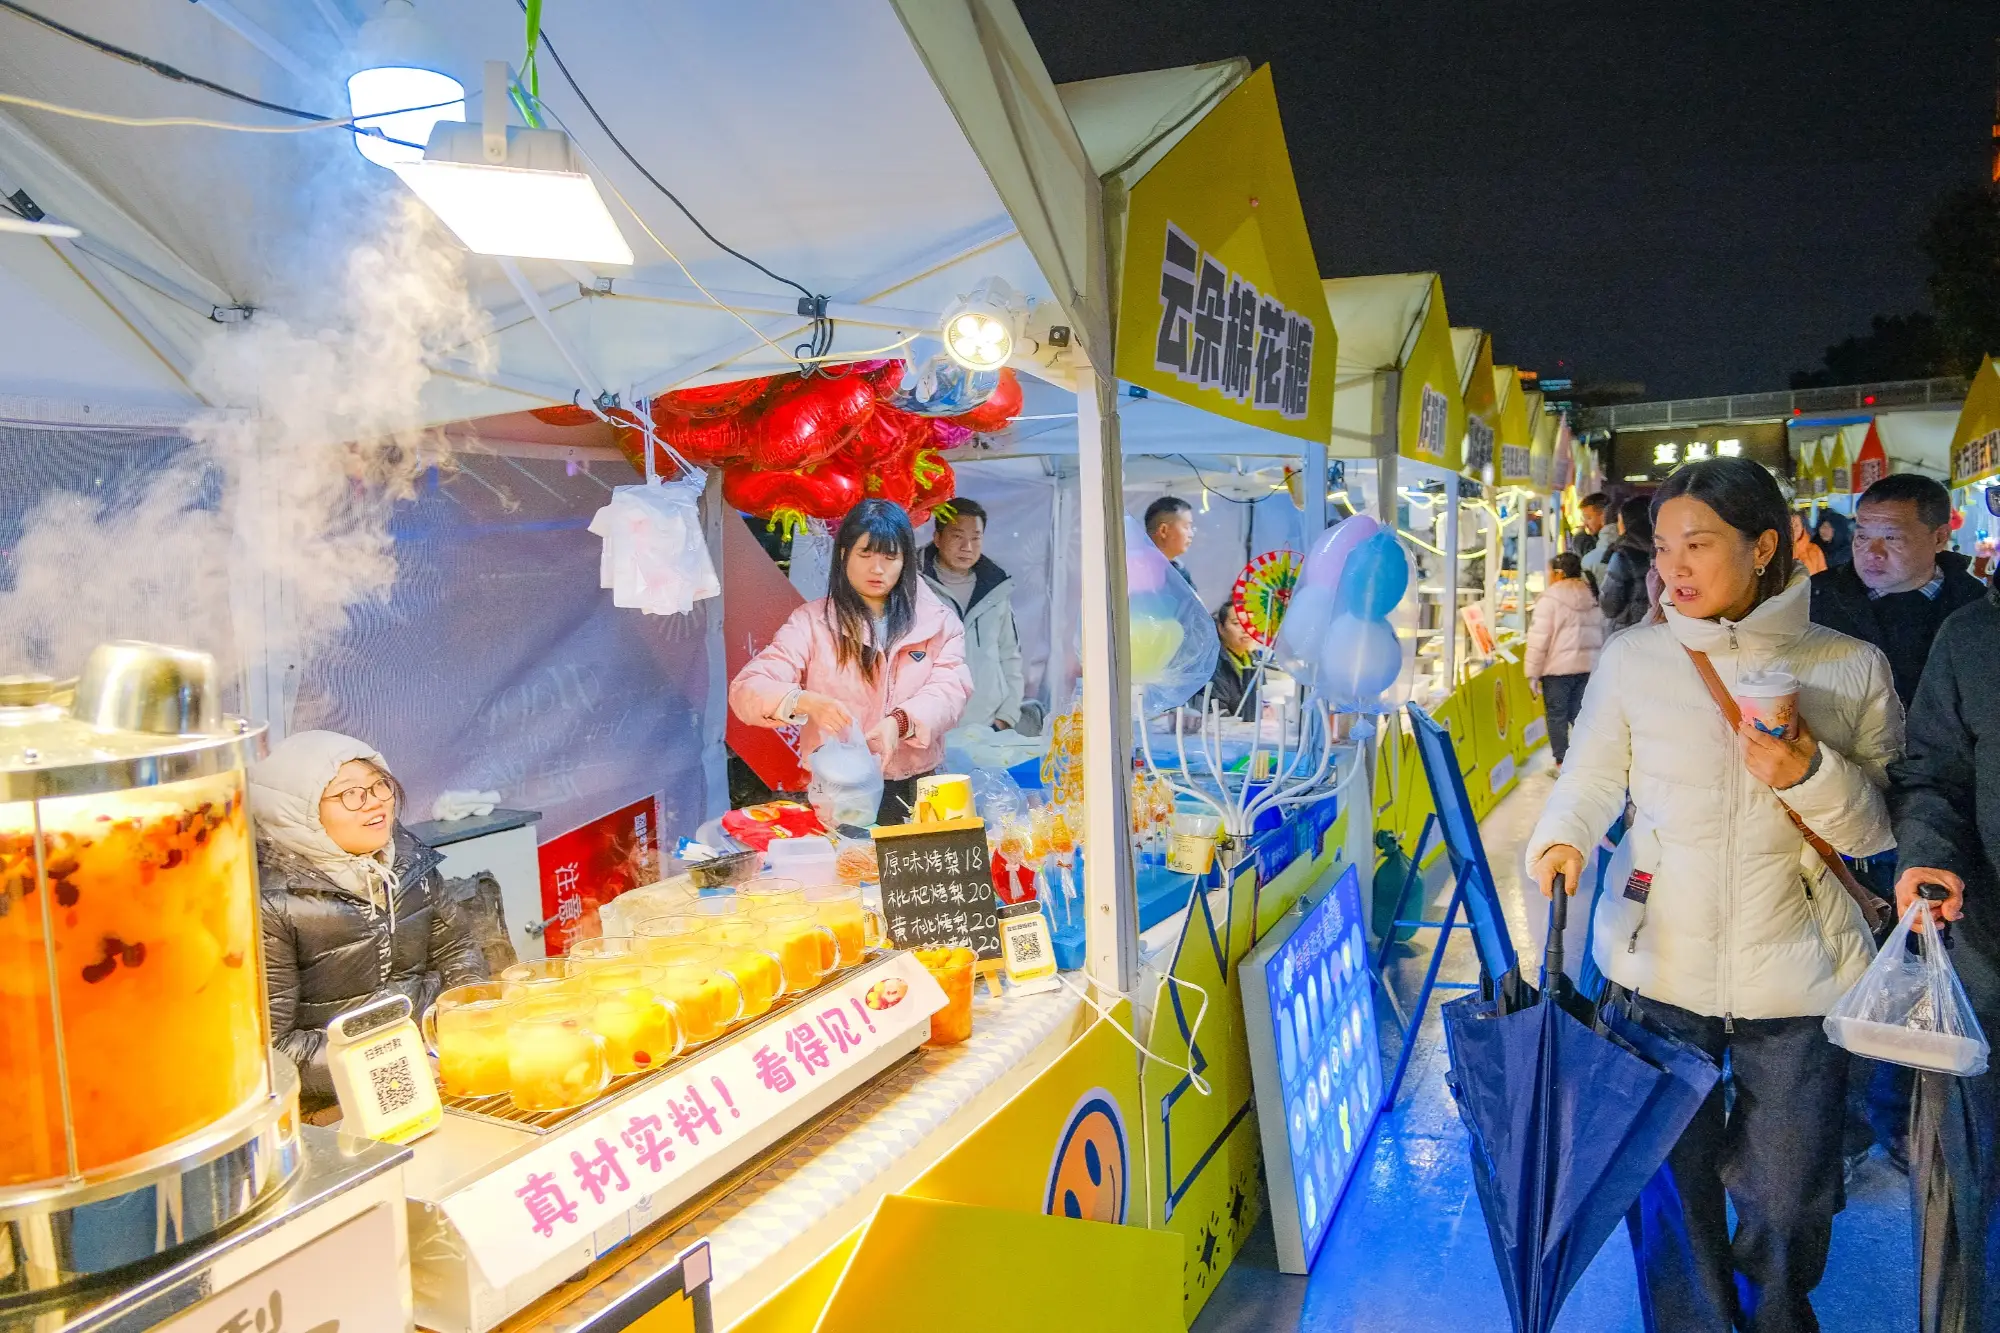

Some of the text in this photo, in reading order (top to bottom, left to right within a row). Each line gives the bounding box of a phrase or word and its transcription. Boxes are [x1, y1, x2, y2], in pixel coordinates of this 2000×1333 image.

[1156, 222, 1315, 419] 云朵棉花糖
[515, 998, 876, 1238] 真材实料！ 看得见！
